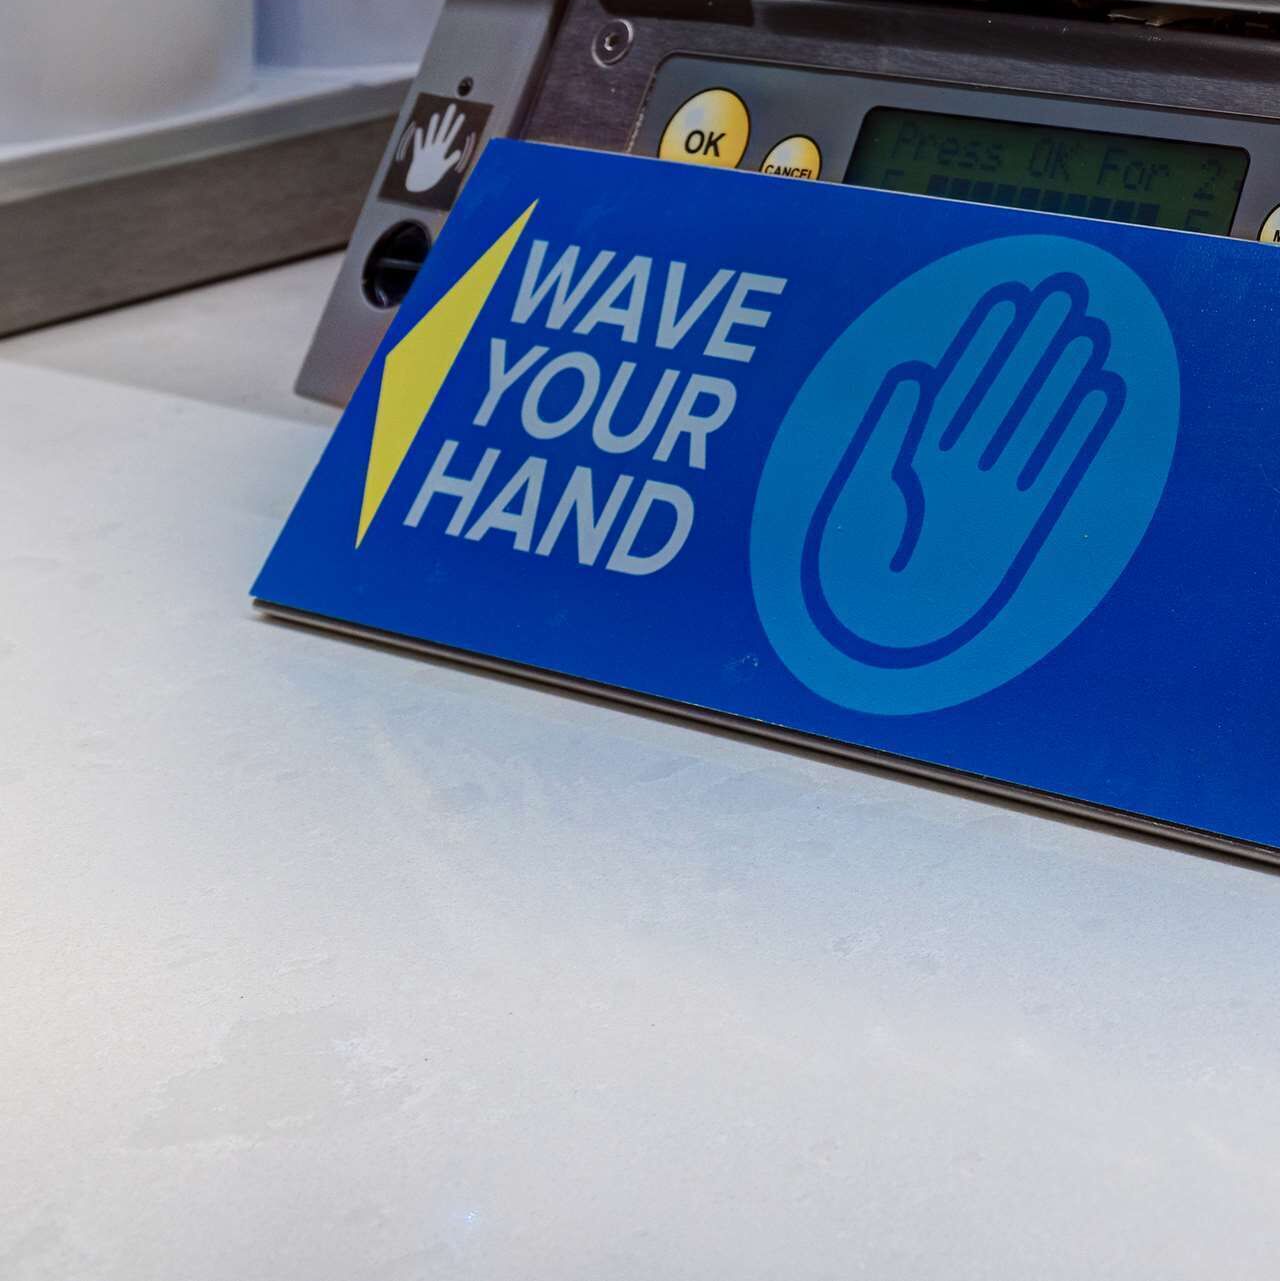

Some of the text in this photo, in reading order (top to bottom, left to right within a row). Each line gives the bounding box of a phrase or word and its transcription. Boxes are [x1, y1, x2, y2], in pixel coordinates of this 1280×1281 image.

[685, 130, 726, 157] OK
[891, 121, 1004, 172] Press
[1029, 135, 1080, 182] OK
[511, 239, 788, 362] WAVE
[472, 337, 737, 470] YOUR
[403, 439, 694, 576] HAND
